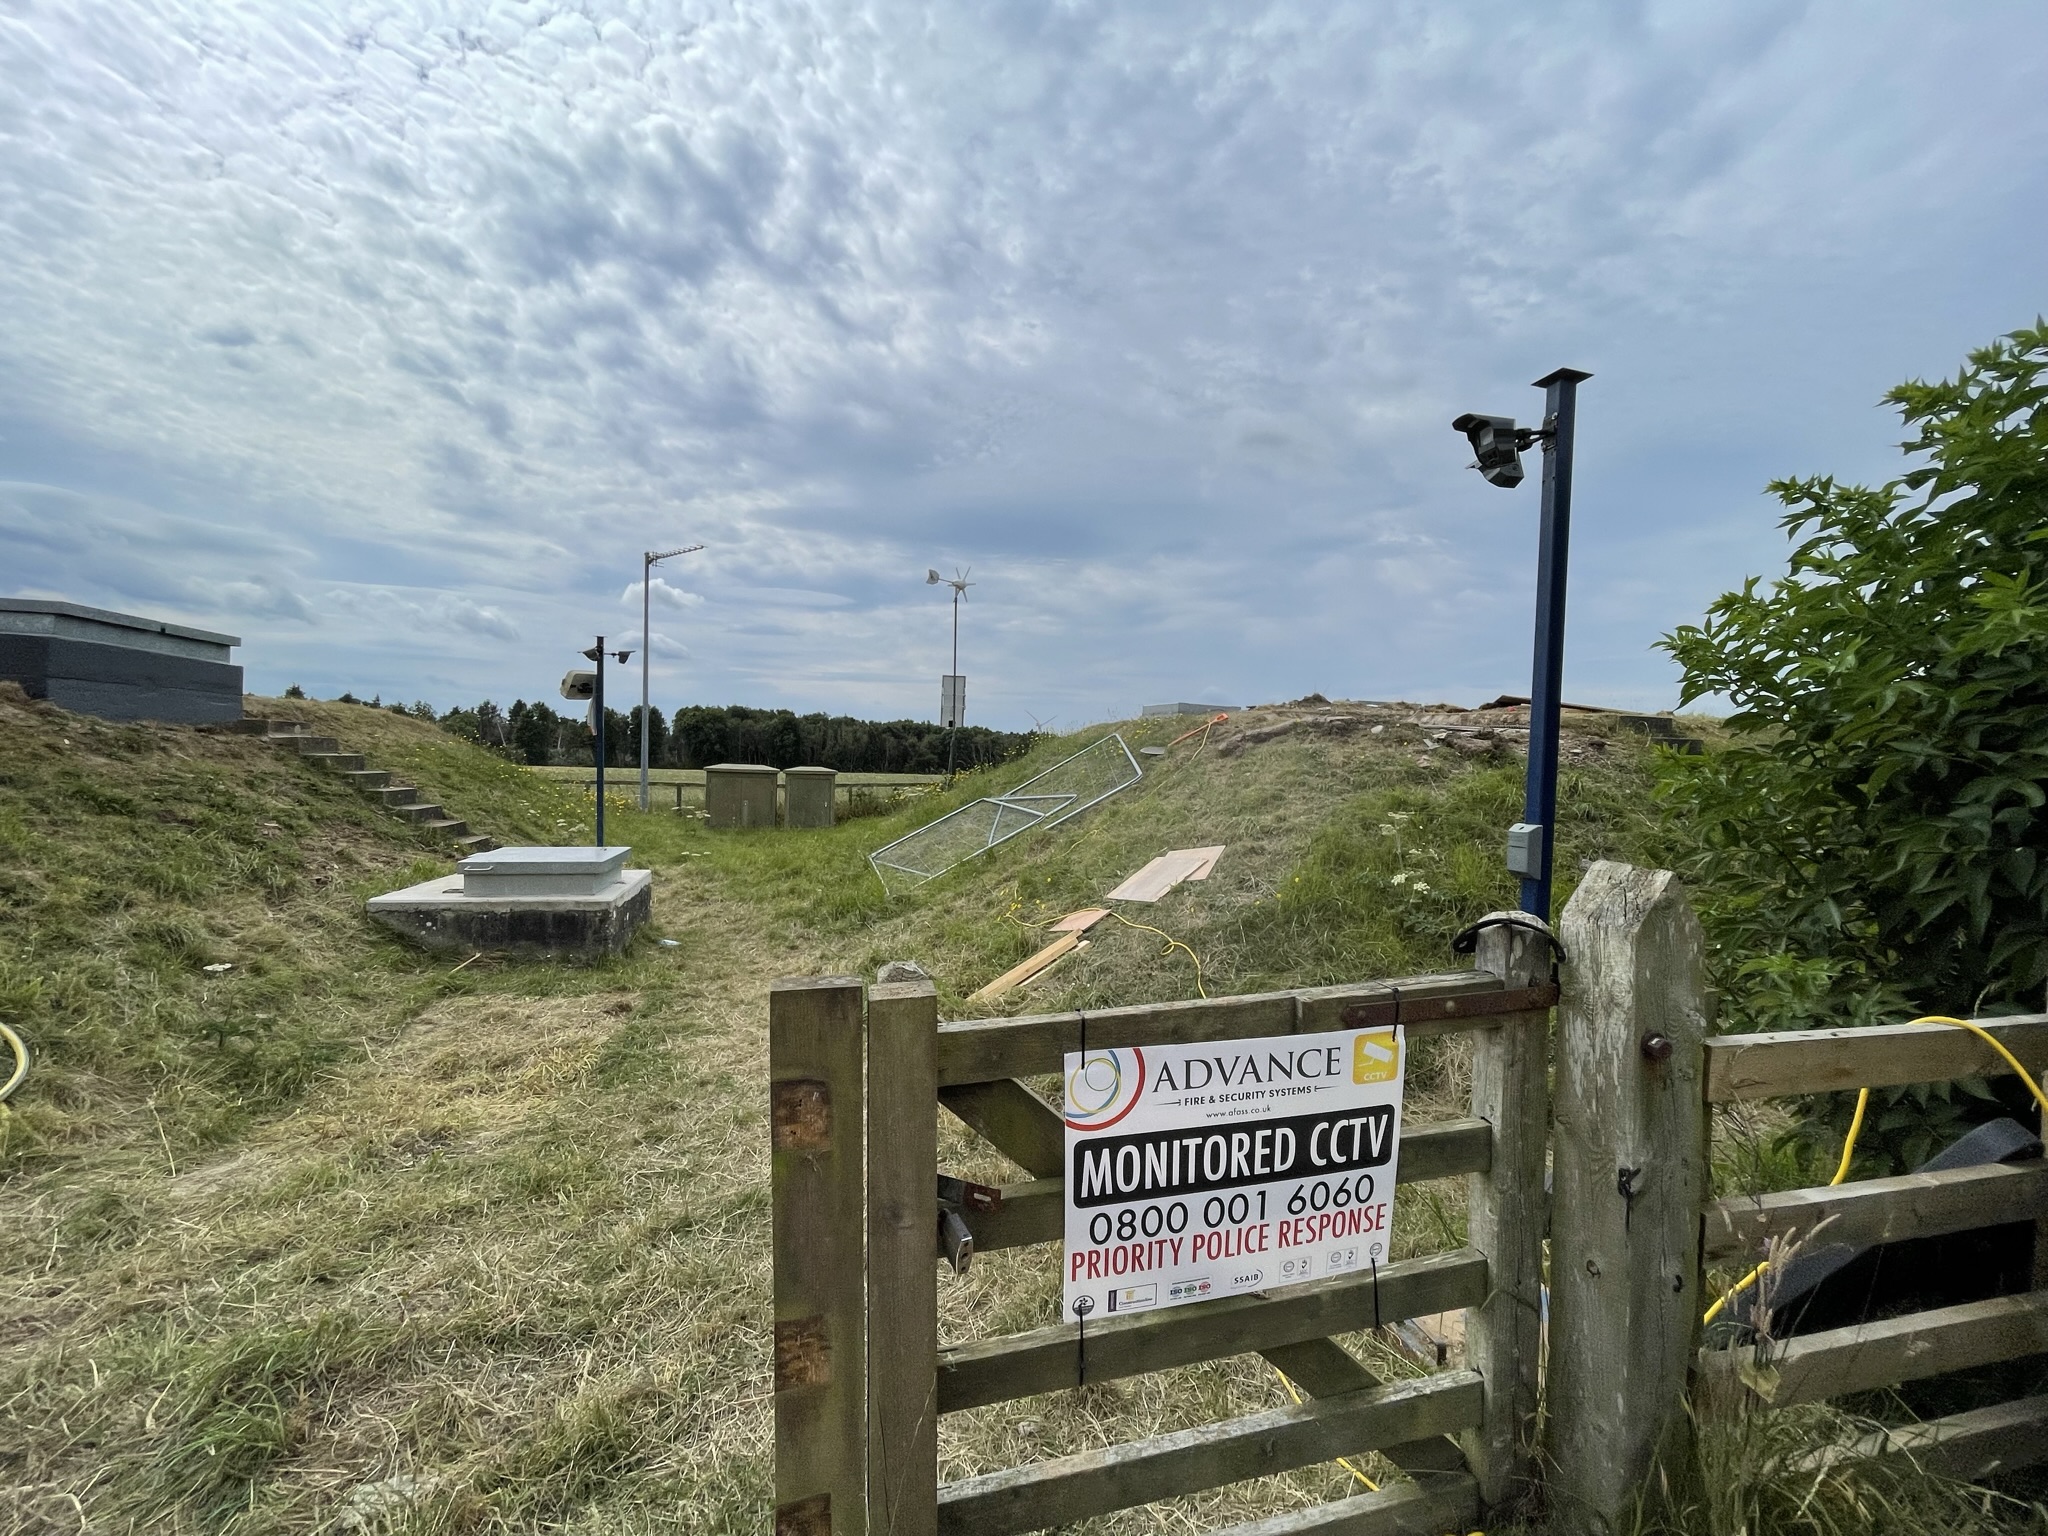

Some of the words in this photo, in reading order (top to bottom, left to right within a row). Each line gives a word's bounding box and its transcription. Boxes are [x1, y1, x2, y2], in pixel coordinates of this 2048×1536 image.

[1152, 1047, 1342, 1093] ADVANCE
[1363, 1071, 1387, 1081] CCTV
[1184, 1096, 1205, 1106] FIRE
[1208, 1094, 1216, 1104] &
[1219, 1090, 1266, 1103] SECURITY
[1269, 1086, 1311, 1098] SYSTEMS
[1081, 1128, 1295, 1198] MONITORED
[1311, 1115, 1388, 1165] CCTV
[1090, 1202, 1188, 1245] 0800
[1204, 1191, 1266, 1228] 001
[1288, 1174, 1374, 1215] 6060
[1071, 1238, 1183, 1281] PRIORITY
[1192, 1224, 1269, 1263] POLICE
[1278, 1204, 1387, 1248] RESPONSE
[1234, 1272, 1259, 1285] SSAIB
